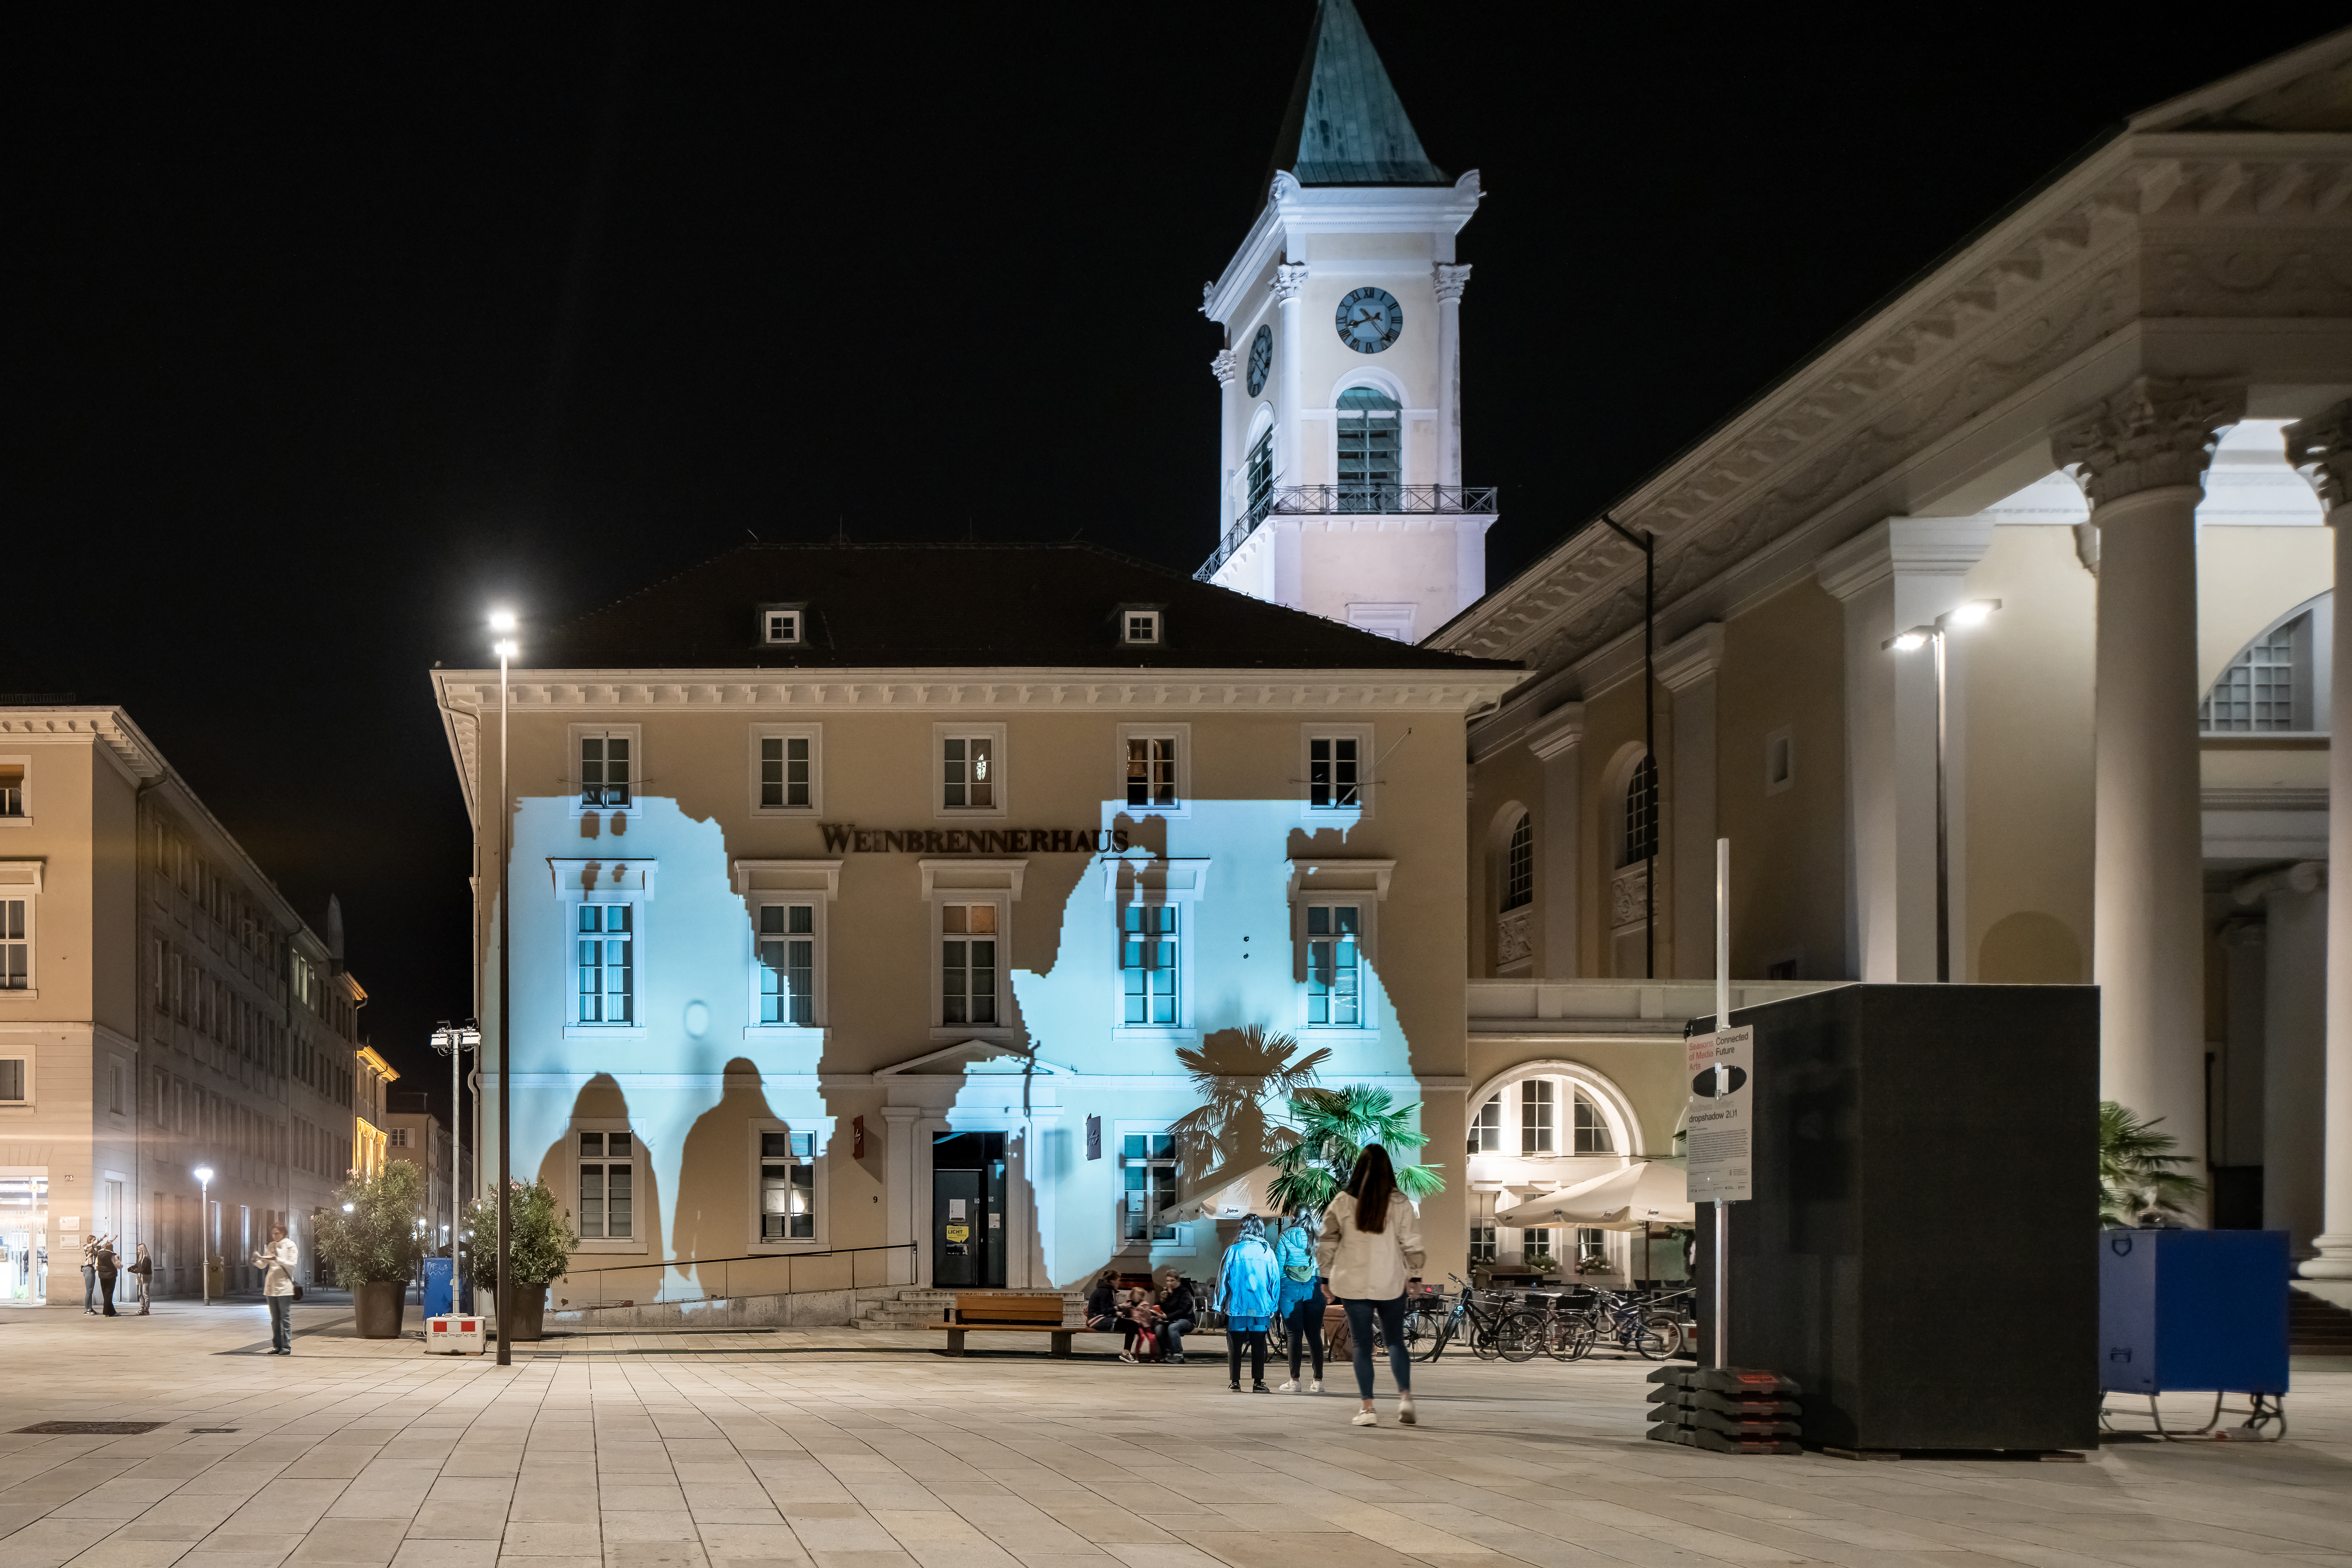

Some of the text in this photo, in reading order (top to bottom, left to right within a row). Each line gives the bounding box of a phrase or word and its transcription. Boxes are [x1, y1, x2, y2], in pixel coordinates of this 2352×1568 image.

[1716, 1031, 1749, 1045] Connected
[1689, 1040, 1714, 1051] Seasons
[1689, 1050, 1713, 1061] of Media
[1716, 1047, 1735, 1056] Future
[1689, 1112, 1724, 1124] dropshadow
